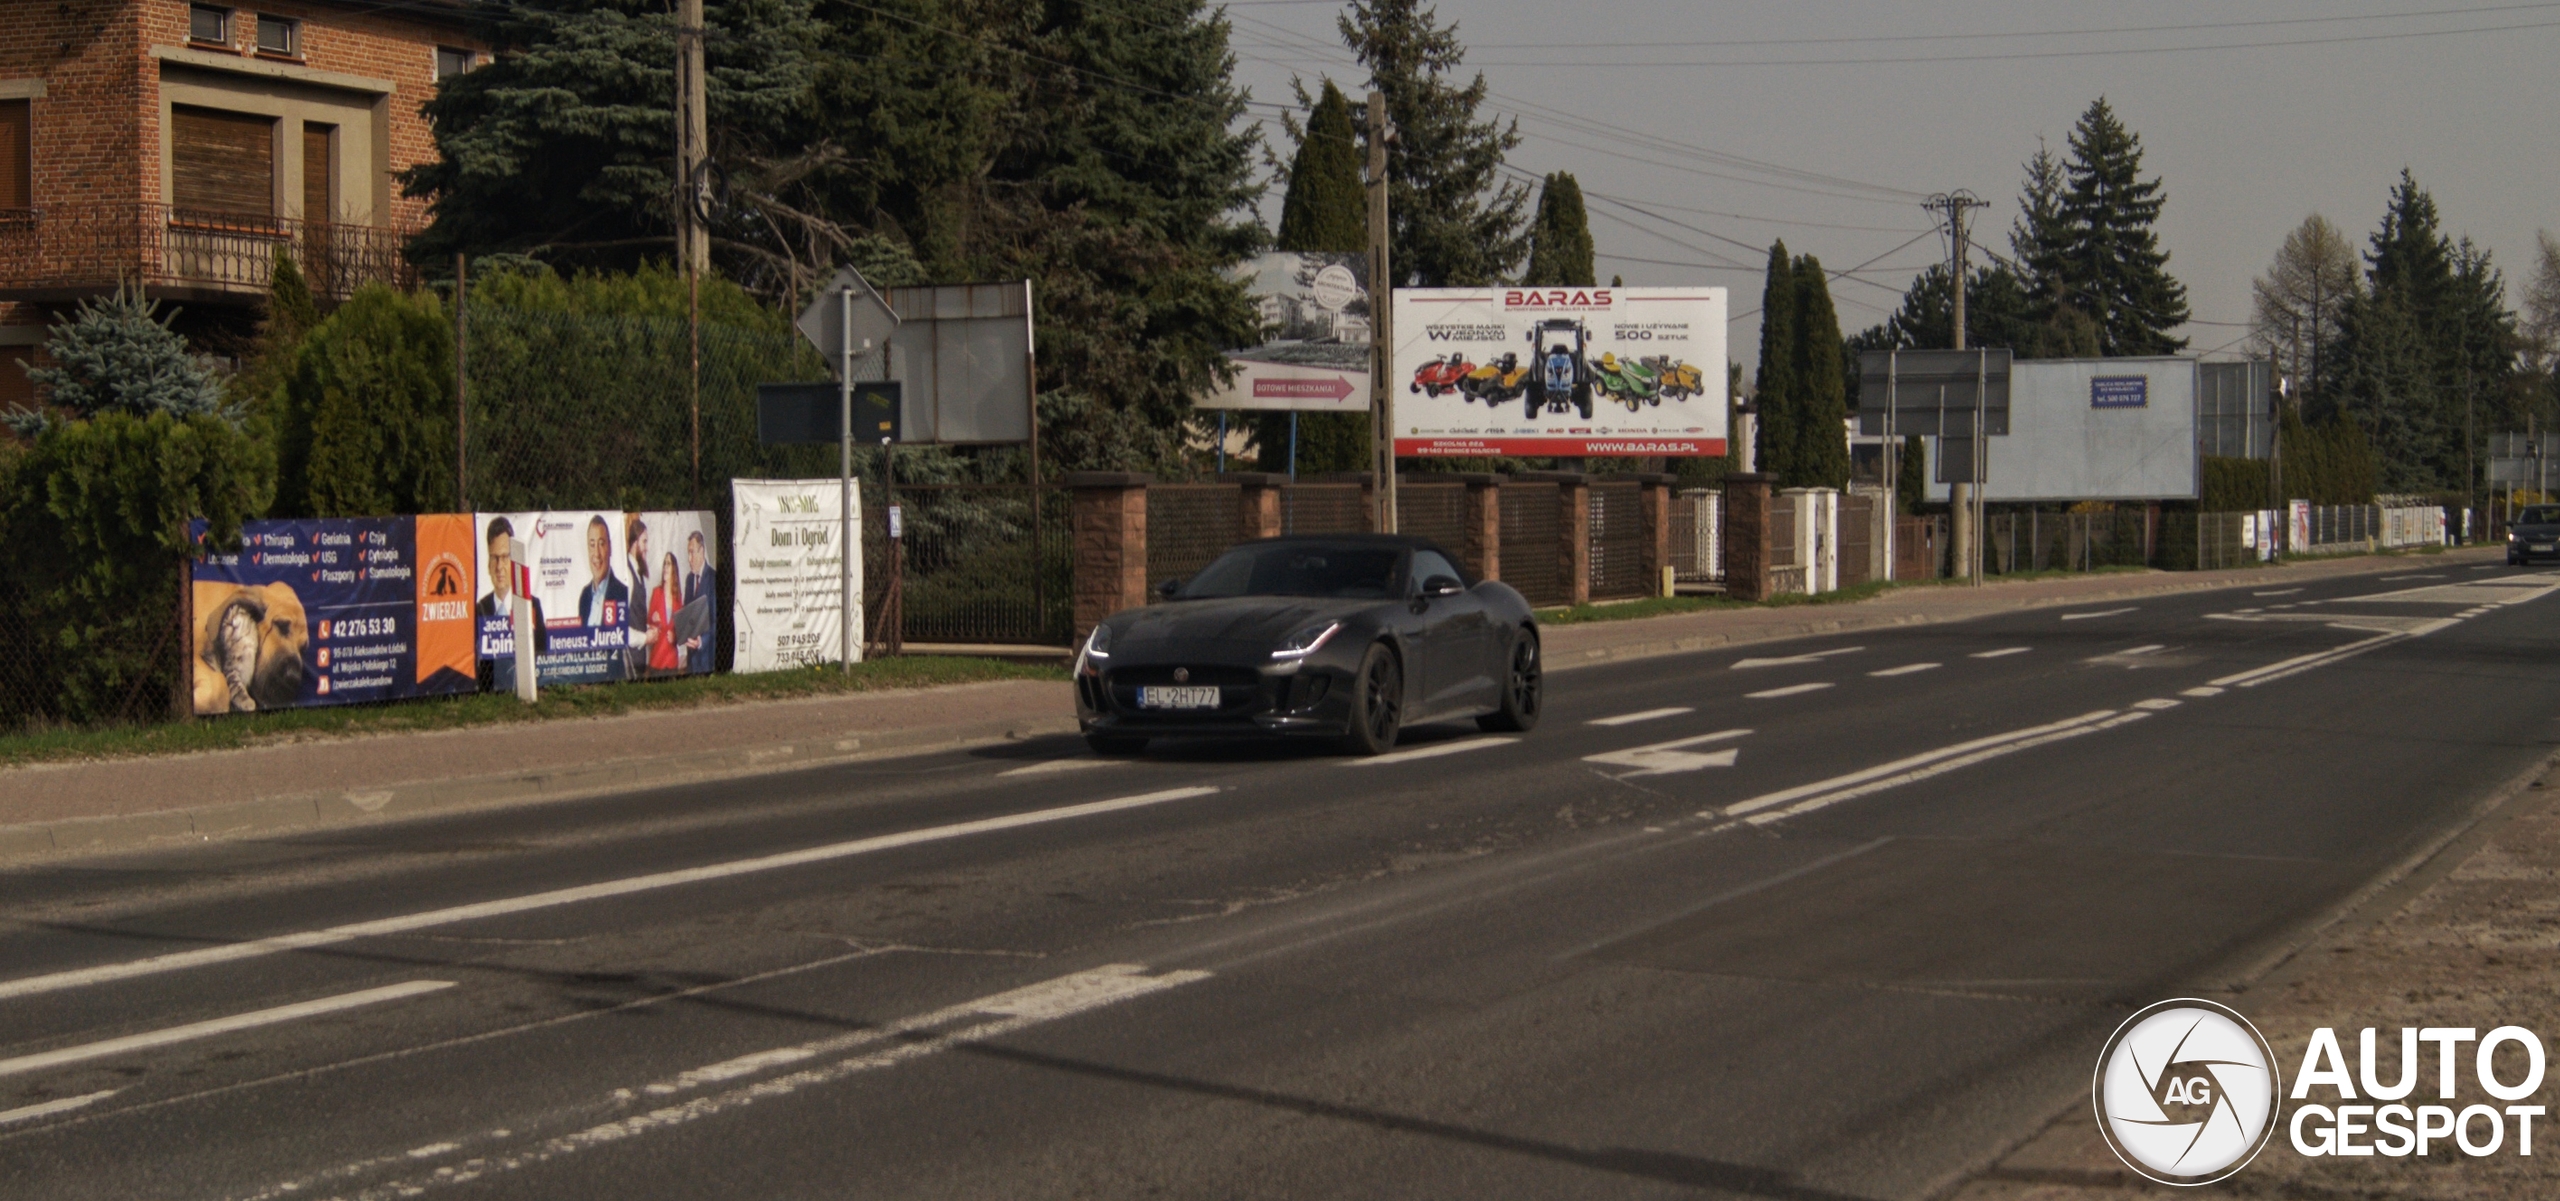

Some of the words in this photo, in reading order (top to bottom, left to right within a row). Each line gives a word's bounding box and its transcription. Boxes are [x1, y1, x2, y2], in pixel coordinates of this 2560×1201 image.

[1505, 290, 1612, 305] BARAS
[1428, 331, 1451, 341] W
[1615, 330, 1652, 340] 500
[1256, 384, 1286, 392] GOTOWE
[1288, 384, 1335, 393] MIESZKANIA!
[1586, 442, 1698, 451] WWW.BARAS.PL
[263, 532, 295, 549] Chirurgia
[322, 532, 351, 545] Geriatria
[771, 528, 792, 547] Dom
[795, 527, 799, 546] i
[802, 524, 828, 551] Ogród
[262, 551, 310, 567] Dermatologia
[321, 550, 337, 563] USG
[322, 569, 355, 583] Paszporty
[369, 565, 411, 580] Stomatologia
[422, 601, 469, 621] ZWIERZAK
[605, 607, 613, 623] 8
[619, 608, 625, 621] 2
[334, 620, 346, 637] 42
[348, 619, 367, 636] 276
[368, 618, 380, 635] 53
[382, 617, 395, 634] 30
[550, 634, 588, 651] Ireneusz
[590, 627, 625, 648] Jurek
[777, 635, 790, 646] 507
[776, 652, 789, 662] 733
[361, 658, 389, 672] Polskiego
[389, 658, 397, 669] 12
[1146, 688, 1165, 703] EL
[1171, 688, 1216, 703] 2HT77
